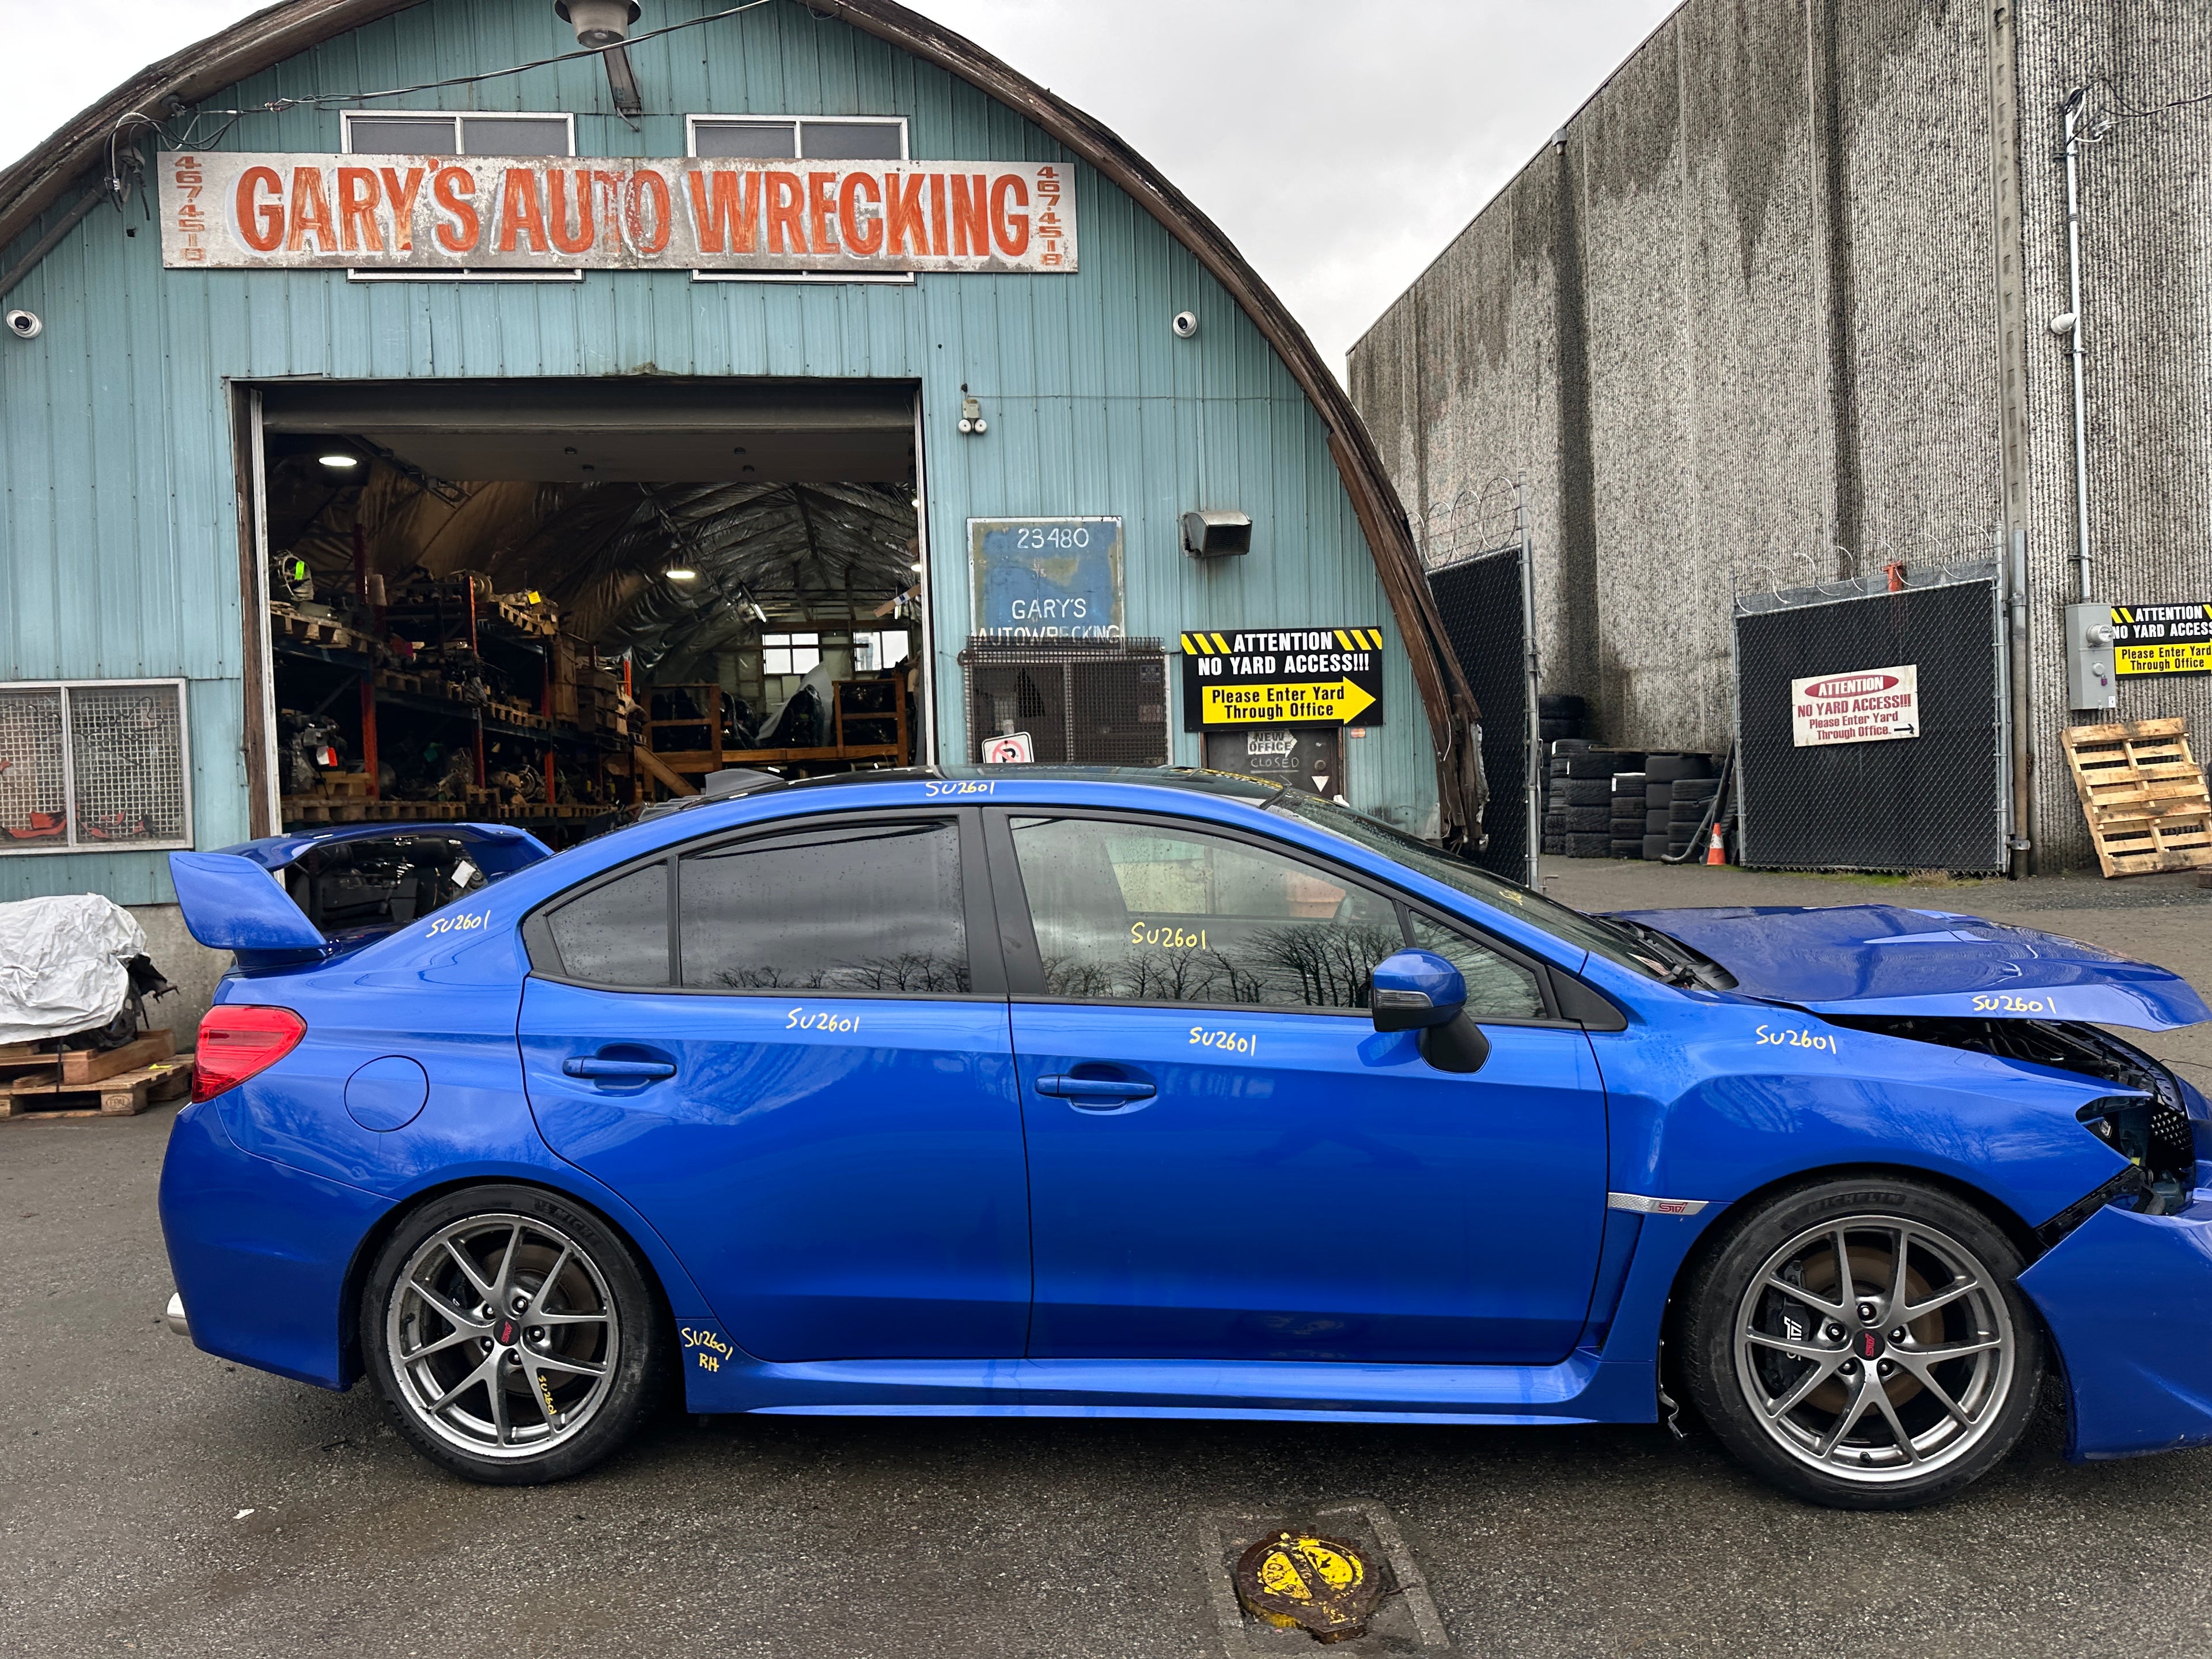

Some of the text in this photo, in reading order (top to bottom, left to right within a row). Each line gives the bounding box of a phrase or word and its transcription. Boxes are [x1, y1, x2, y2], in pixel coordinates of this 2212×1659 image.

[236, 158, 1029, 257] GARY'S AUTO WRECKING
[1017, 527, 1089, 548] 23480
[1012, 598, 1086, 620] GARY'S
[2135, 605, 2202, 622] ATTENTION
[2112, 625, 2128, 639] NO
[2133, 624, 2165, 638] YARD
[1233, 631, 1332, 653] ATTENTION
[2122, 645, 2211, 660] Please Enter Yard
[1198, 653, 1369, 676] NO YARD ACCESS!!!
[2130, 658, 2205, 671] Through Office
[1212, 685, 1344, 704] Please Enter Yard
[1818, 676, 1884, 697] ATTENTION
[1224, 702, 1334, 720] Through Office
[1798, 694, 1911, 718] NO YARD ACCESS!!!
[1809, 711, 1899, 729] Please Enter Yard
[1255, 731, 1285, 742] NEW
[1817, 728, 1855, 740] Through
[1249, 741, 1291, 752] OFFICE
[1251, 757, 1300, 768] CLOSED
[925, 781, 995, 797] SU2601
[426, 910, 491, 938] SU2601
[1131, 922, 1206, 950] SU2601
[1972, 995, 2056, 1014] SU2601
[786, 1007, 859, 1033] SU2601
[1189, 1027, 1256, 1056] SU2601
[1756, 1025, 1836, 1055] SU2601
[681, 1327, 733, 1361] SU2601
[699, 1353, 719, 1372] RH
[538, 1375, 557, 1415] SU2601
